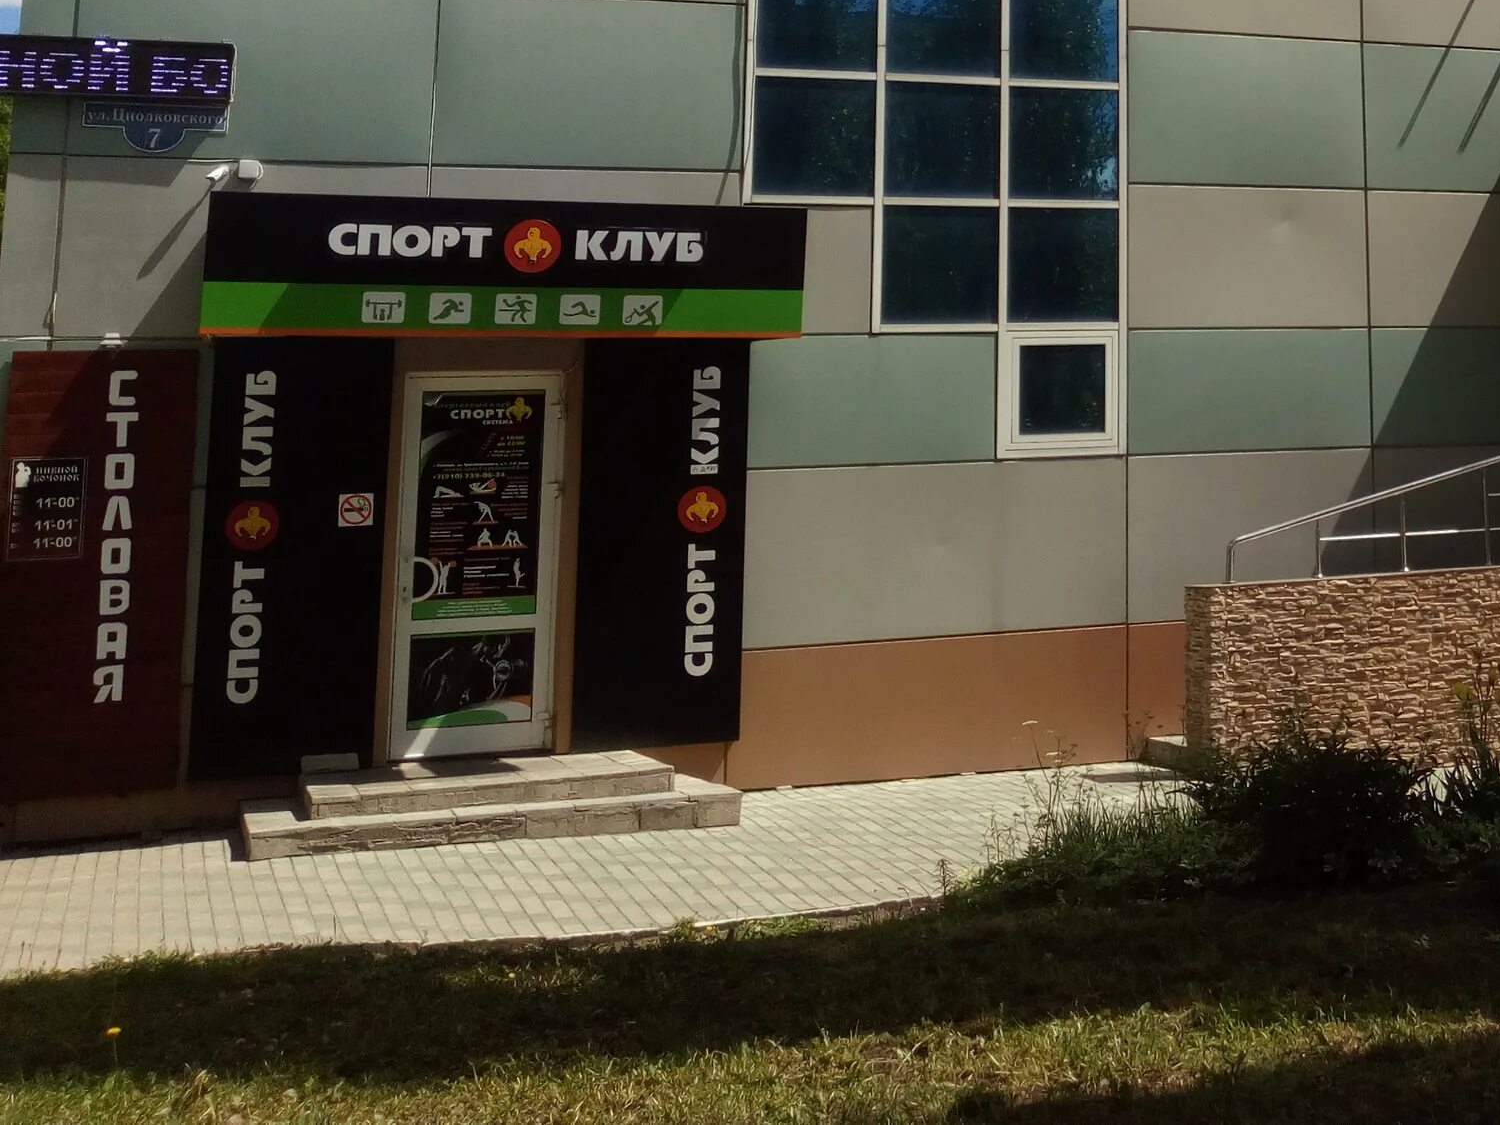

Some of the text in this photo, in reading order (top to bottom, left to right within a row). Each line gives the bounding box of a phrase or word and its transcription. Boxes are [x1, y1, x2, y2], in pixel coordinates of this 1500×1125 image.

[87, 107, 225, 125] ул. Циолковского
[147, 127, 162, 149] 7
[327, 222, 705, 264] СПОРТ КЛУБ
[450, 408, 506, 420] СПОРТ
[33, 474, 80, 483] БОЧОНОК
[36, 465, 79, 475] ПИВНОЙ
[683, 365, 722, 678] СПОРТ КЛУБ
[92, 369, 140, 704] СТОЛОВАЯ
[226, 369, 277, 705] СПОРТ КЛУБ
